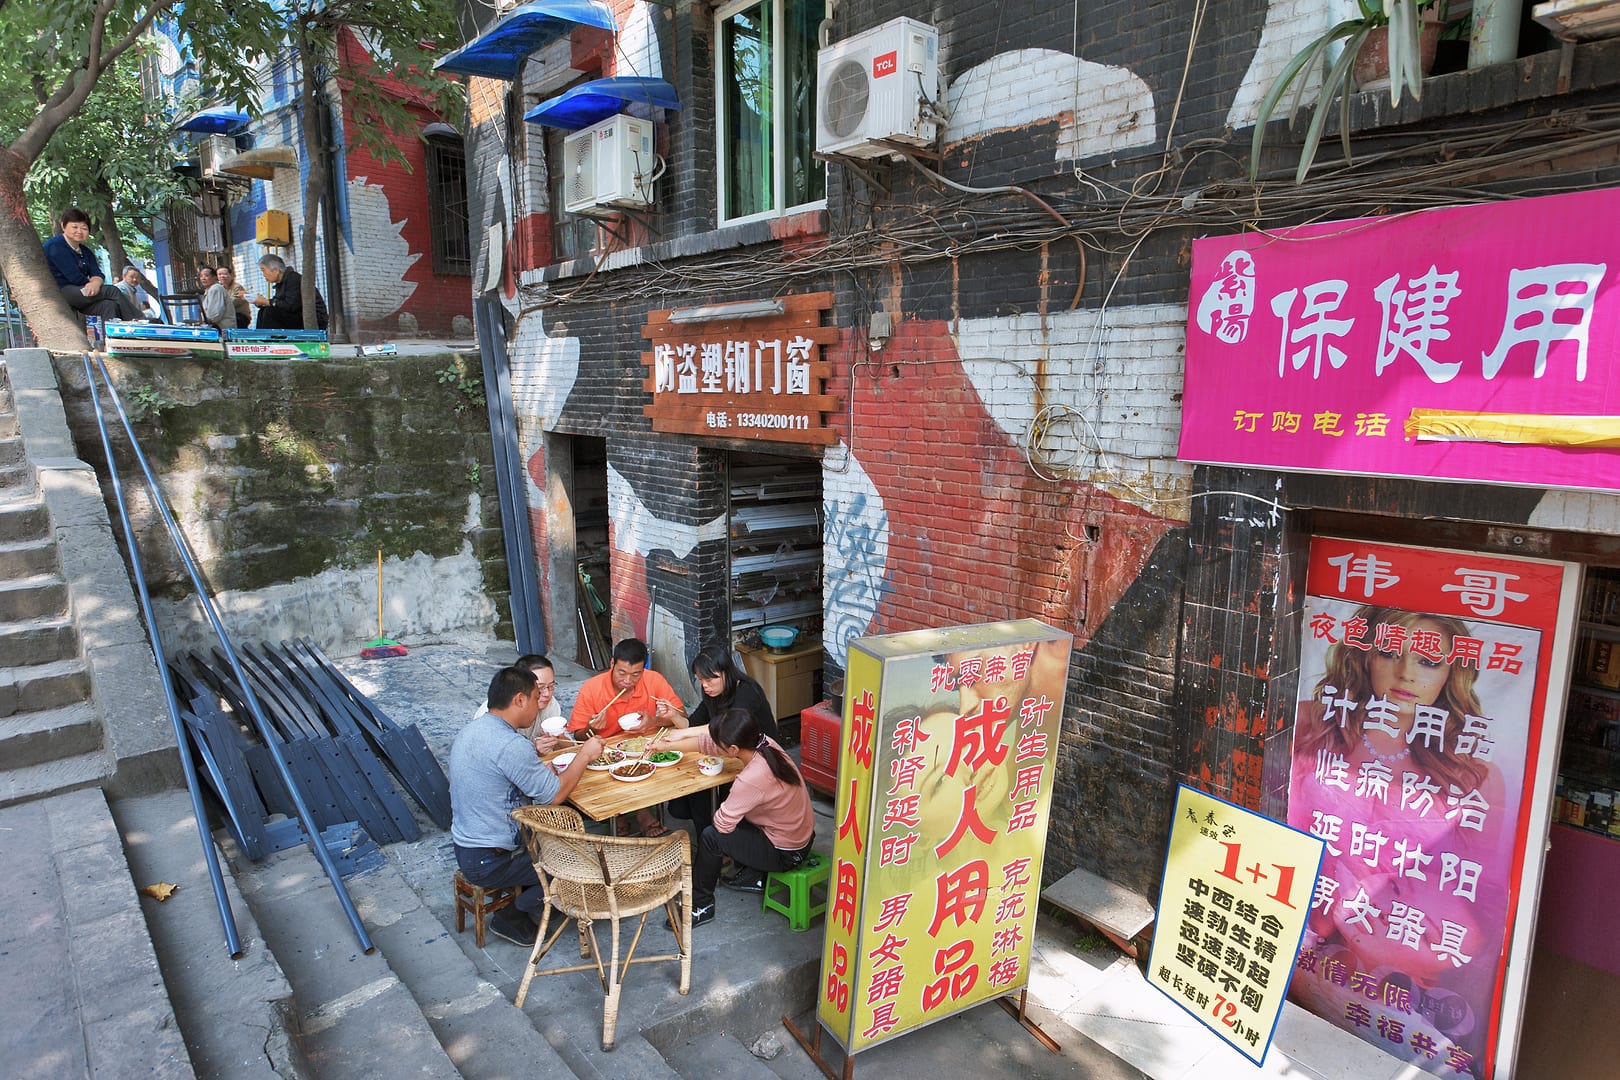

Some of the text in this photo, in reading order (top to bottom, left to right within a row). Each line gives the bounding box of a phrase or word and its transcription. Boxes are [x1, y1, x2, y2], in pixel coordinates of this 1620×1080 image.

[876, 59, 894, 72] TCL
[1270, 262, 1607, 383] 保健用
[654, 336, 814, 394] 防盗塑钢门窗
[1328, 552, 1529, 617] 伟哥
[931, 651, 1034, 693] 批零兼营
[1309, 612, 1524, 675] 夜色情趣用品
[1320, 684, 1495, 763] 计生用品
[880, 715, 931, 868] 补肾延时
[1006, 694, 1054, 834] 计生用品
[1314, 748, 1490, 832] 性病防治
[827, 689, 876, 1014] 成人用品
[921, 695, 1012, 1013] 成人用品
[1214, 841, 1297, 910] 1+1
[1309, 809, 1483, 903] 延时壮阳
[1183, 898, 1279, 964] 速勃生精
[1188, 877, 1285, 939] 中西结合
[1311, 874, 1472, 968] 男女器具
[862, 892, 913, 1039] 男女器具
[1175, 942, 1264, 1014] 坚硬不倒
[1178, 919, 1271, 990] 迅速勃起
[1343, 1000, 1475, 1076] 幸福共享
